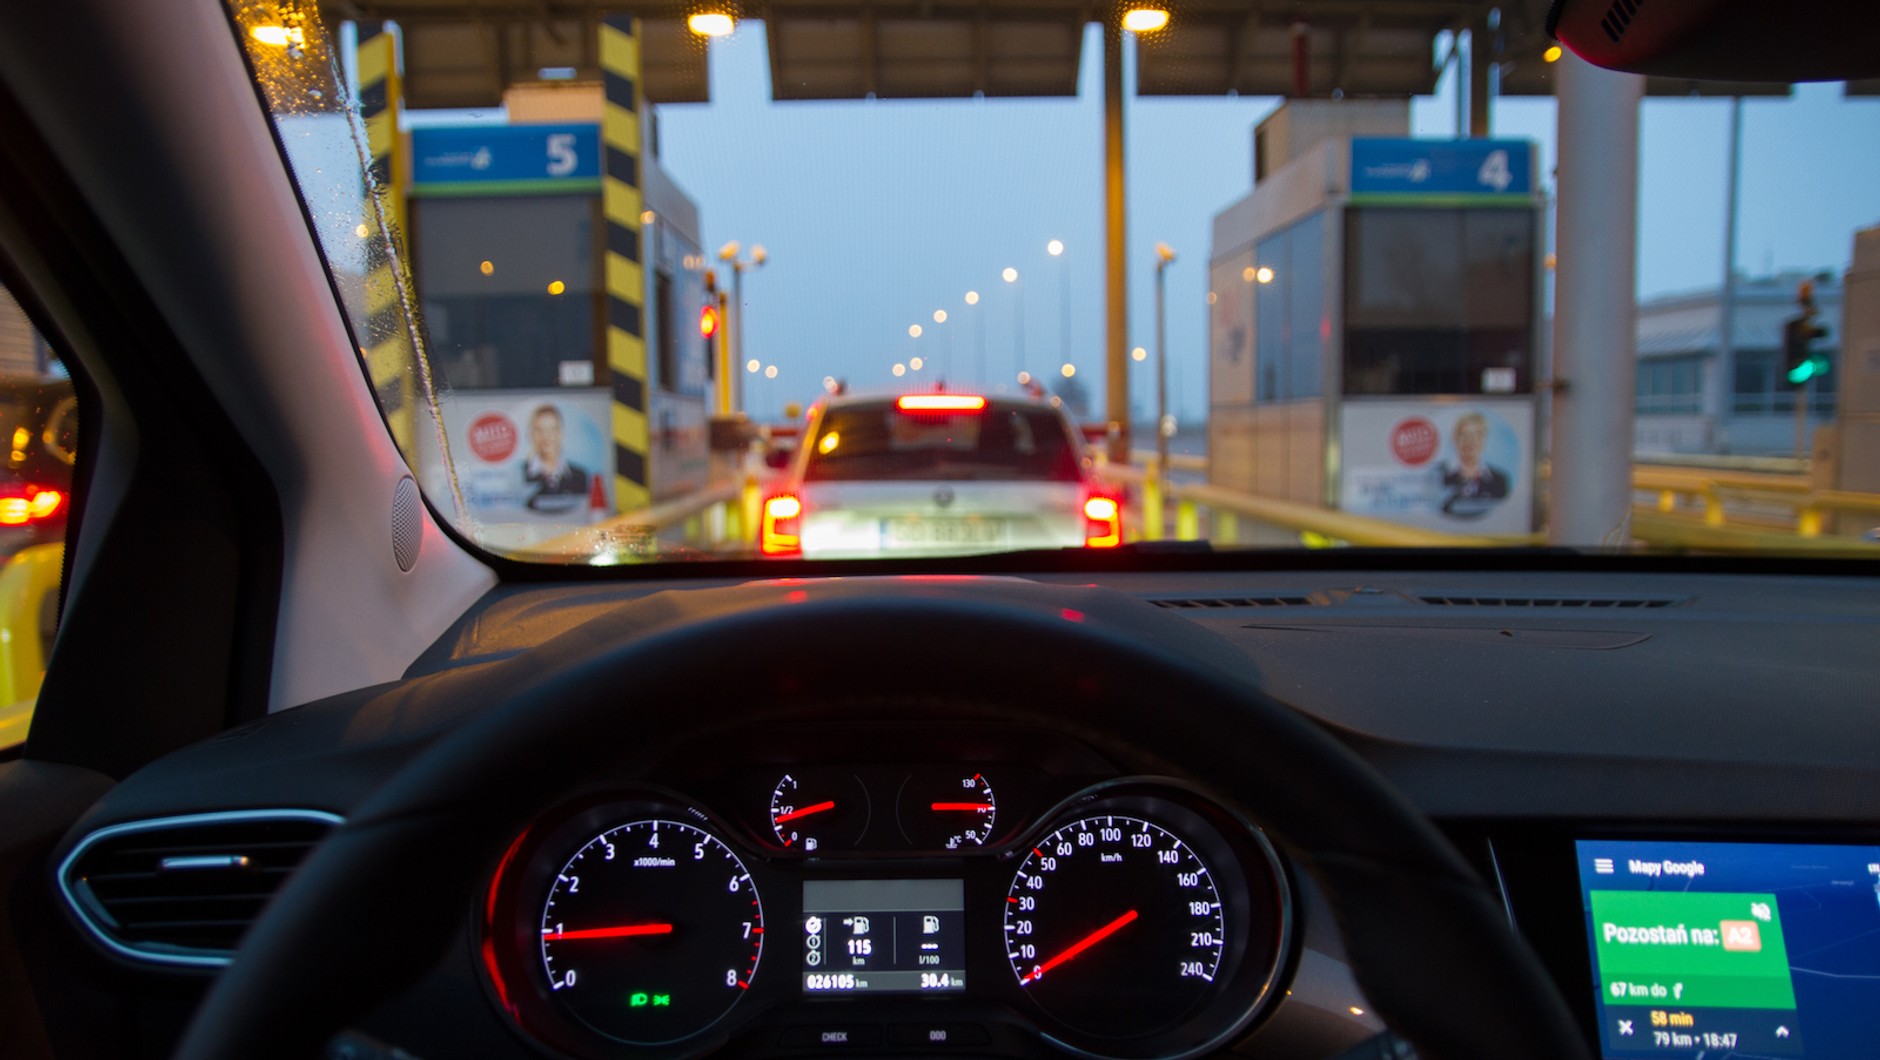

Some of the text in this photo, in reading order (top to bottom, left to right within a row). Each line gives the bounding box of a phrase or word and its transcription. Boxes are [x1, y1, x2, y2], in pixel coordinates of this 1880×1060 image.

[545, 132, 579, 177] 5
[1477, 149, 1513, 190] 4
[792, 780, 798, 789] 1
[962, 779, 976, 788] 130
[780, 806, 793, 815] 1/2
[649, 833, 659, 848] 4
[791, 832, 797, 841] 0
[965, 830, 976, 839] 50
[1078, 832, 1094, 847] 80
[1100, 828, 1121, 842] 100
[1131, 834, 1151, 847] 120
[605, 844, 615, 860] 3
[694, 843, 704, 859] 5
[1056, 842, 1072, 856] 60
[634, 858, 675, 867] x1000/min
[1041, 857, 1056, 871] 50
[1101, 853, 1122, 862] km/h
[1158, 850, 1178, 864] 140
[1628, 860, 1705, 878] Mapy Google
[569, 876, 579, 892] 2
[729, 876, 739, 891] 6
[1026, 876, 1042, 890] 40
[1177, 873, 1198, 886] 160
[1019, 896, 1035, 911] 30
[1189, 902, 1210, 915] 180
[555, 923, 564, 940] 1
[742, 922, 751, 938] 7
[1017, 921, 1032, 934] 20
[1602, 922, 1753, 945] Pozostań na: A2
[1191, 933, 1212, 946] 210
[848, 939, 872, 955] 115
[1020, 945, 1035, 958] 10
[852, 957, 865, 965] km
[1033, 965, 1042, 979] 0
[1181, 962, 1203, 976] 240
[566, 970, 576, 986] 0
[726, 970, 737, 986] 8
[806, 974, 868, 990] 026105 km
[921, 973, 963, 988] 30.4 km
[1610, 982, 1667, 998] 67 km do
[1650, 1010, 1694, 1027] 58 min
[822, 1032, 848, 1042] CHECK
[1653, 1031, 1737, 1048] 79 km 18:47
